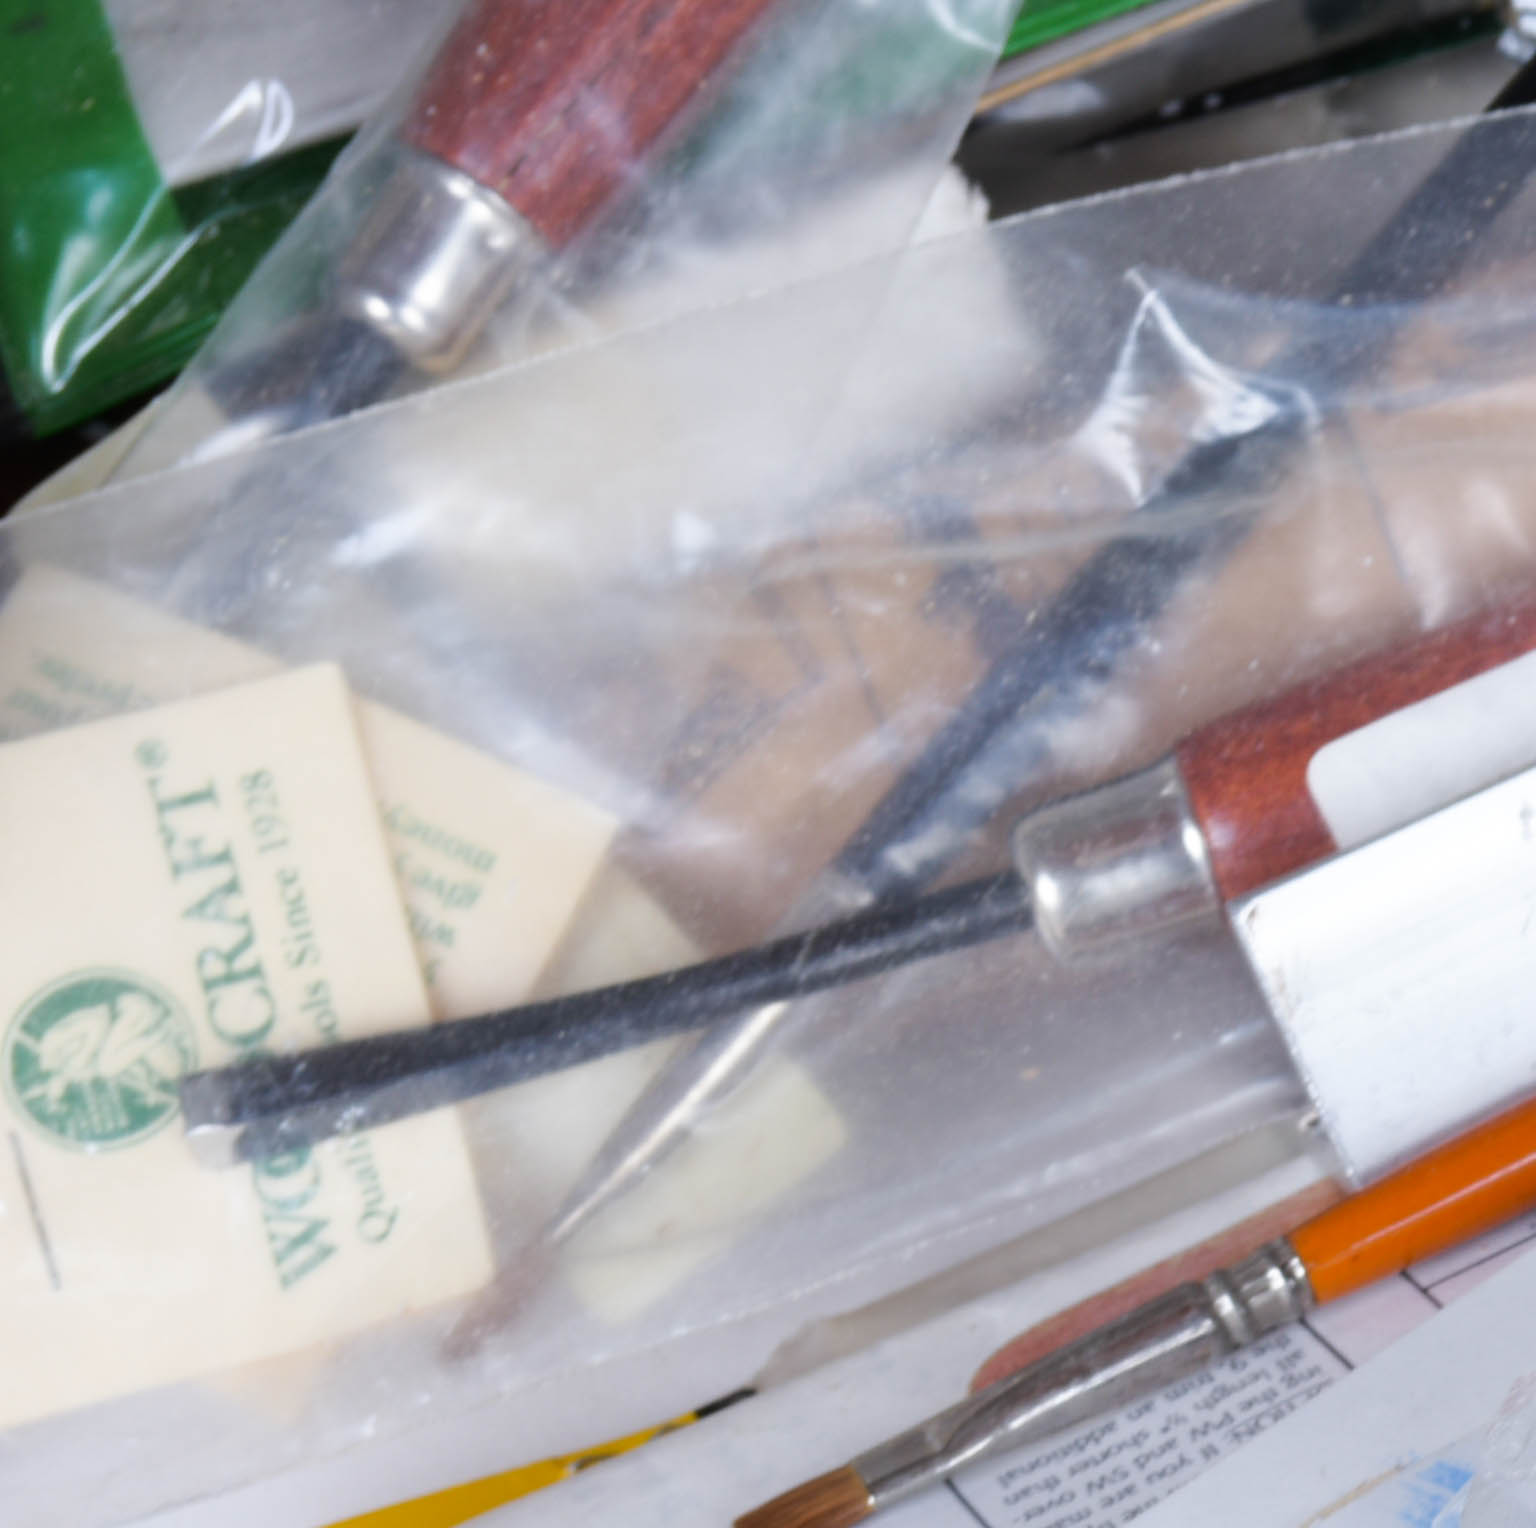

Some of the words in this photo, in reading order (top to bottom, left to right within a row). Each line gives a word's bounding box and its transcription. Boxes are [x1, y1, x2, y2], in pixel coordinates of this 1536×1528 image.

[239, 767, 290, 855] 1928
[277, 866, 321, 972] Since
[997, 1417, 1119, 1489] additional
[1068, 1429, 1153, 1478] shorter
[1133, 1437, 1180, 1472] and
[1146, 1456, 1193, 1486] you
